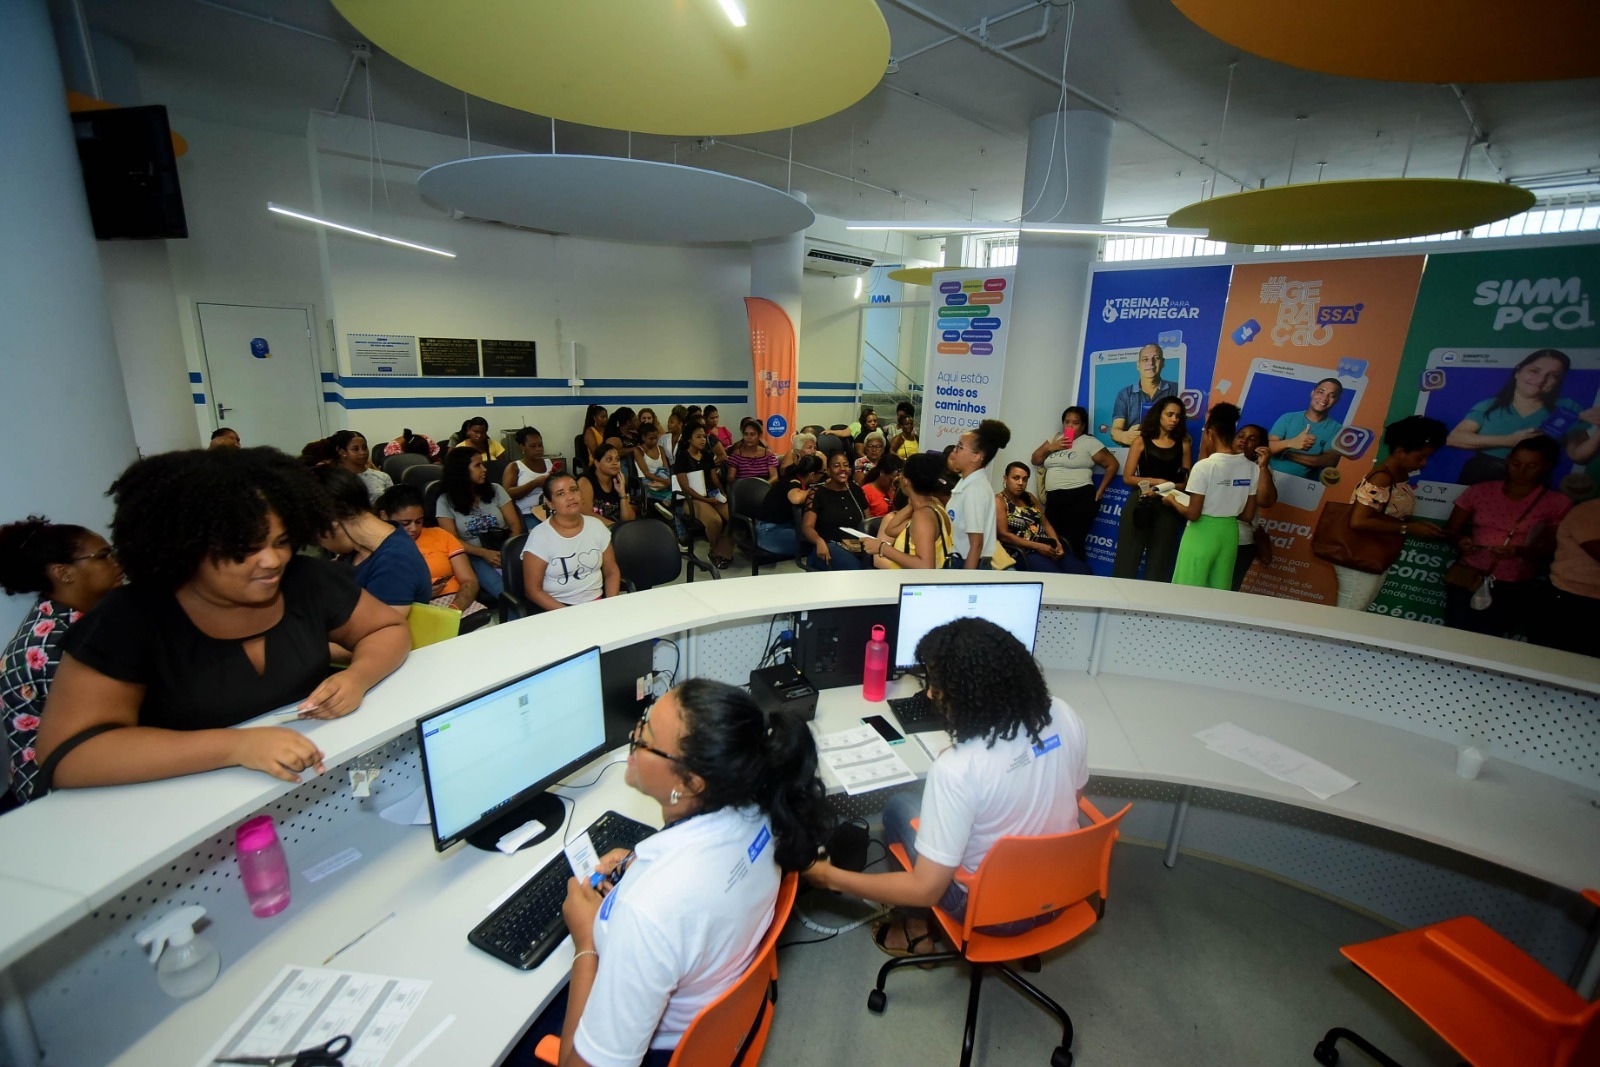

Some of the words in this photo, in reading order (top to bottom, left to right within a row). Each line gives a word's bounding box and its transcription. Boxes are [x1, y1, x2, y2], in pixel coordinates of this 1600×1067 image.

[1472, 276, 1581, 306] SIMM
[1114, 297, 1170, 308] TREINAR
[1119, 307, 1200, 319] EMPREGAR
[1320, 309, 1355, 321] SSA
[937, 371, 958, 385] Aqui
[960, 373, 989, 384] estão
[936, 385, 964, 397] todos
[966, 389, 978, 398] os
[935, 400, 986, 414] caminhos
[934, 414, 956, 426] para
[958, 417, 964, 426] o
[1258, 517, 1314, 539] epara,
[1093, 547, 1116, 556] oportun
[1288, 559, 1310, 568] para
[1388, 564, 1442, 584] cons
[1290, 587, 1324, 600] batendo
[1381, 588, 1407, 598] onde
[1409, 593, 1437, 605] cada
[1390, 605, 1403, 617] é
